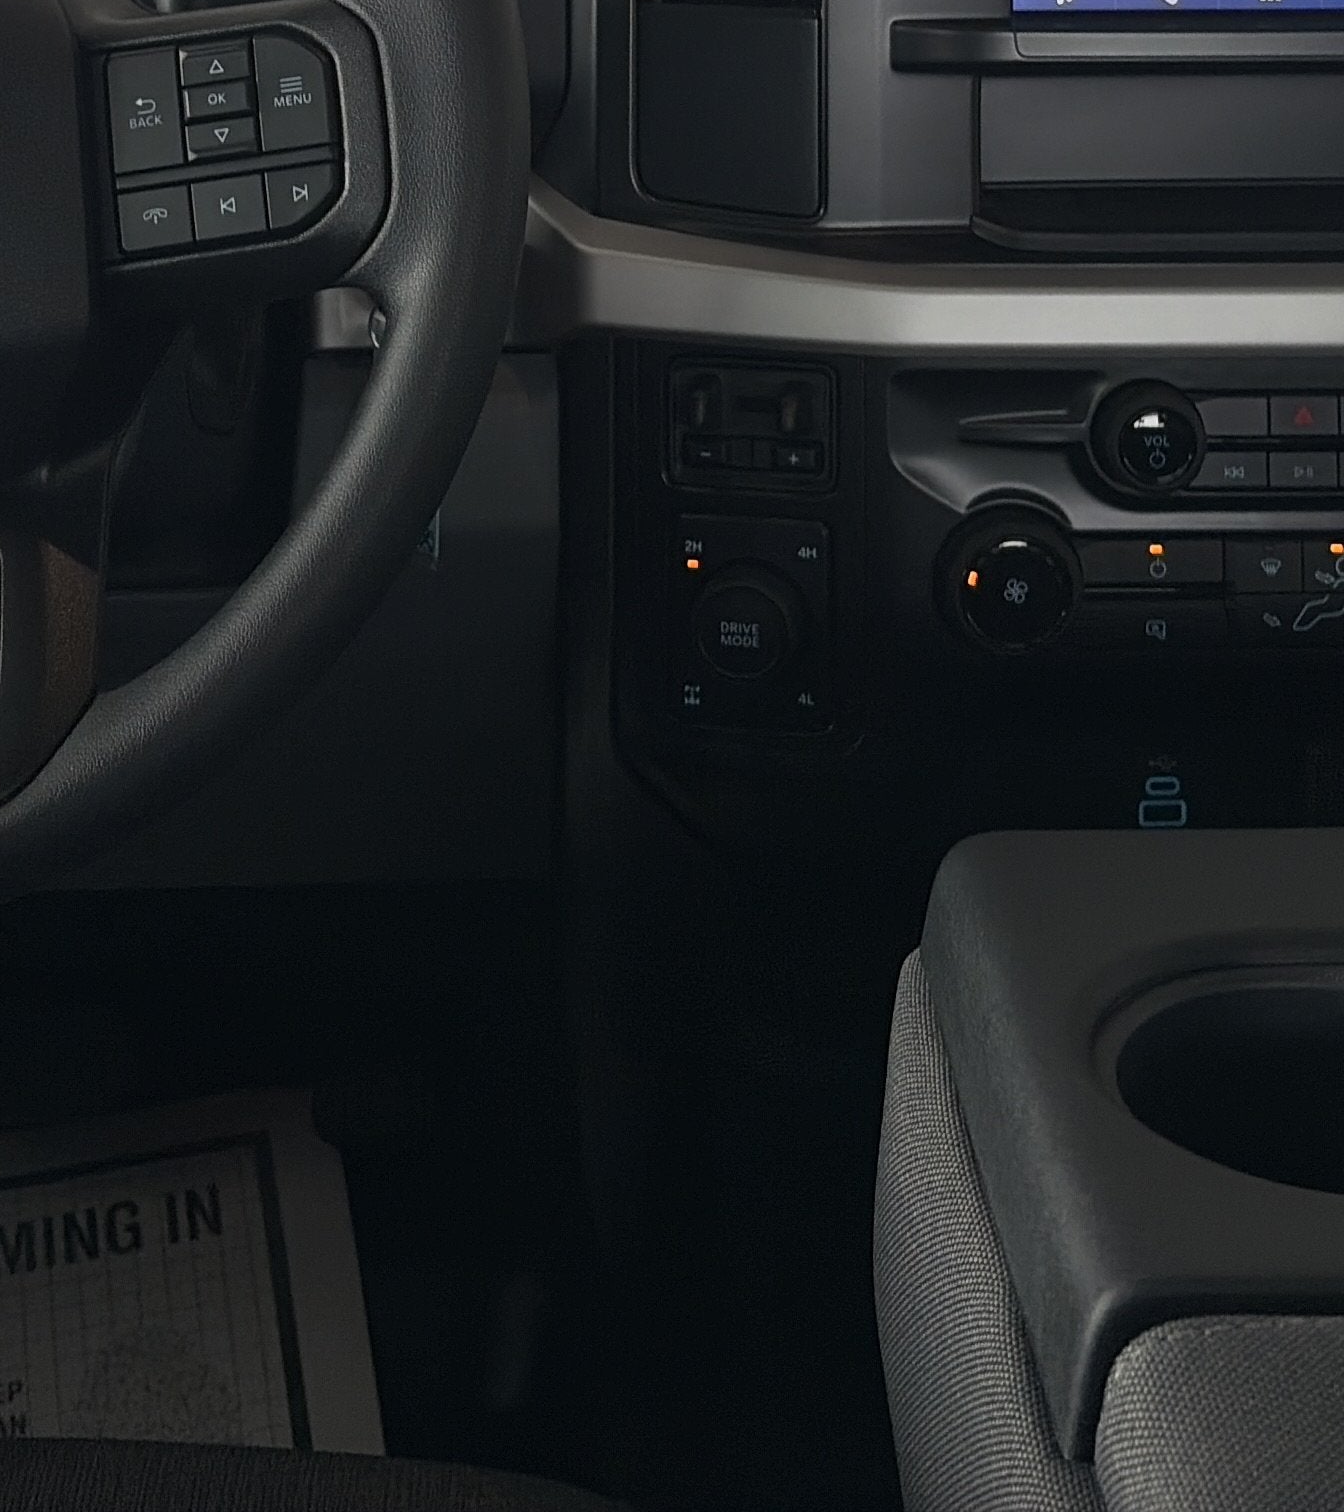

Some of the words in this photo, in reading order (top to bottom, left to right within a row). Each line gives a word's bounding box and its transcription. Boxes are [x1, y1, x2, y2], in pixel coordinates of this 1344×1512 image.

[207, 93, 226, 105] OK
[273, 93, 312, 108] MENU
[129, 115, 163, 130] BACK
[1144, 436, 1170, 448] VOL
[684, 540, 703, 553] 2H
[797, 546, 817, 560] 4H
[720, 621, 760, 635] DRIVE
[720, 635, 760, 648] MODE
[797, 692, 815, 705] 4L
[167, 1182, 224, 1244] IN
